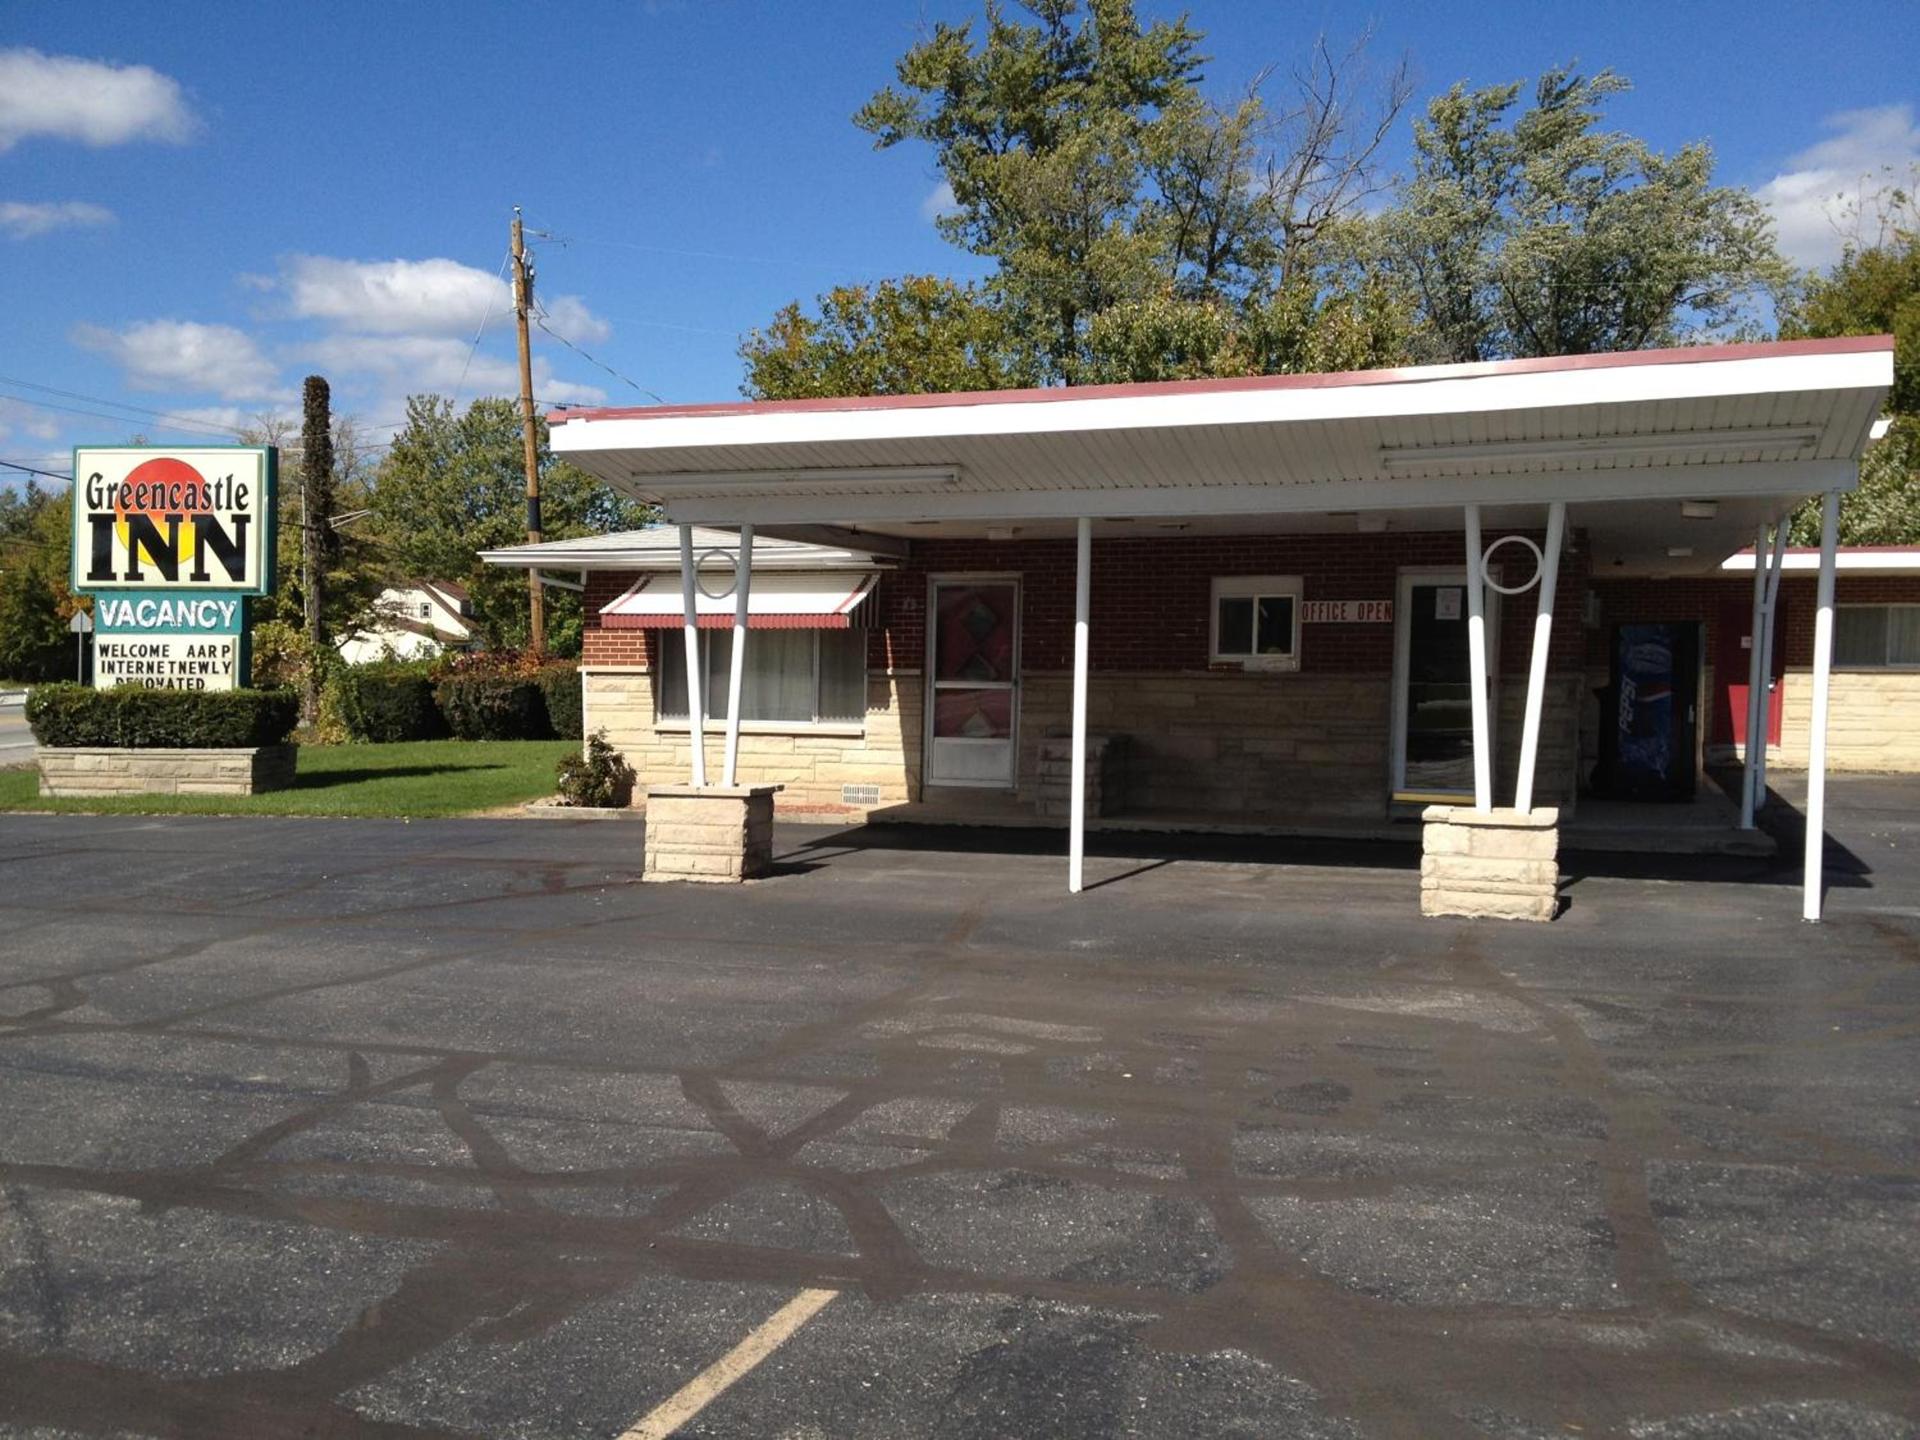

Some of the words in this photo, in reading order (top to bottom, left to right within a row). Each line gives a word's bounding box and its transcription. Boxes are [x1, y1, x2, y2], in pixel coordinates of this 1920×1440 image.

[86, 472, 249, 511] Greencastle
[87, 513, 251, 582] INN
[99, 599, 238, 628] VACANCY
[1302, 602, 1348, 621] OFFICE
[1357, 602, 1393, 621] OPEN
[99, 644, 170, 658] WELCOME
[187, 644, 231, 658] AARP
[1618, 674, 1638, 735] PEPSI
